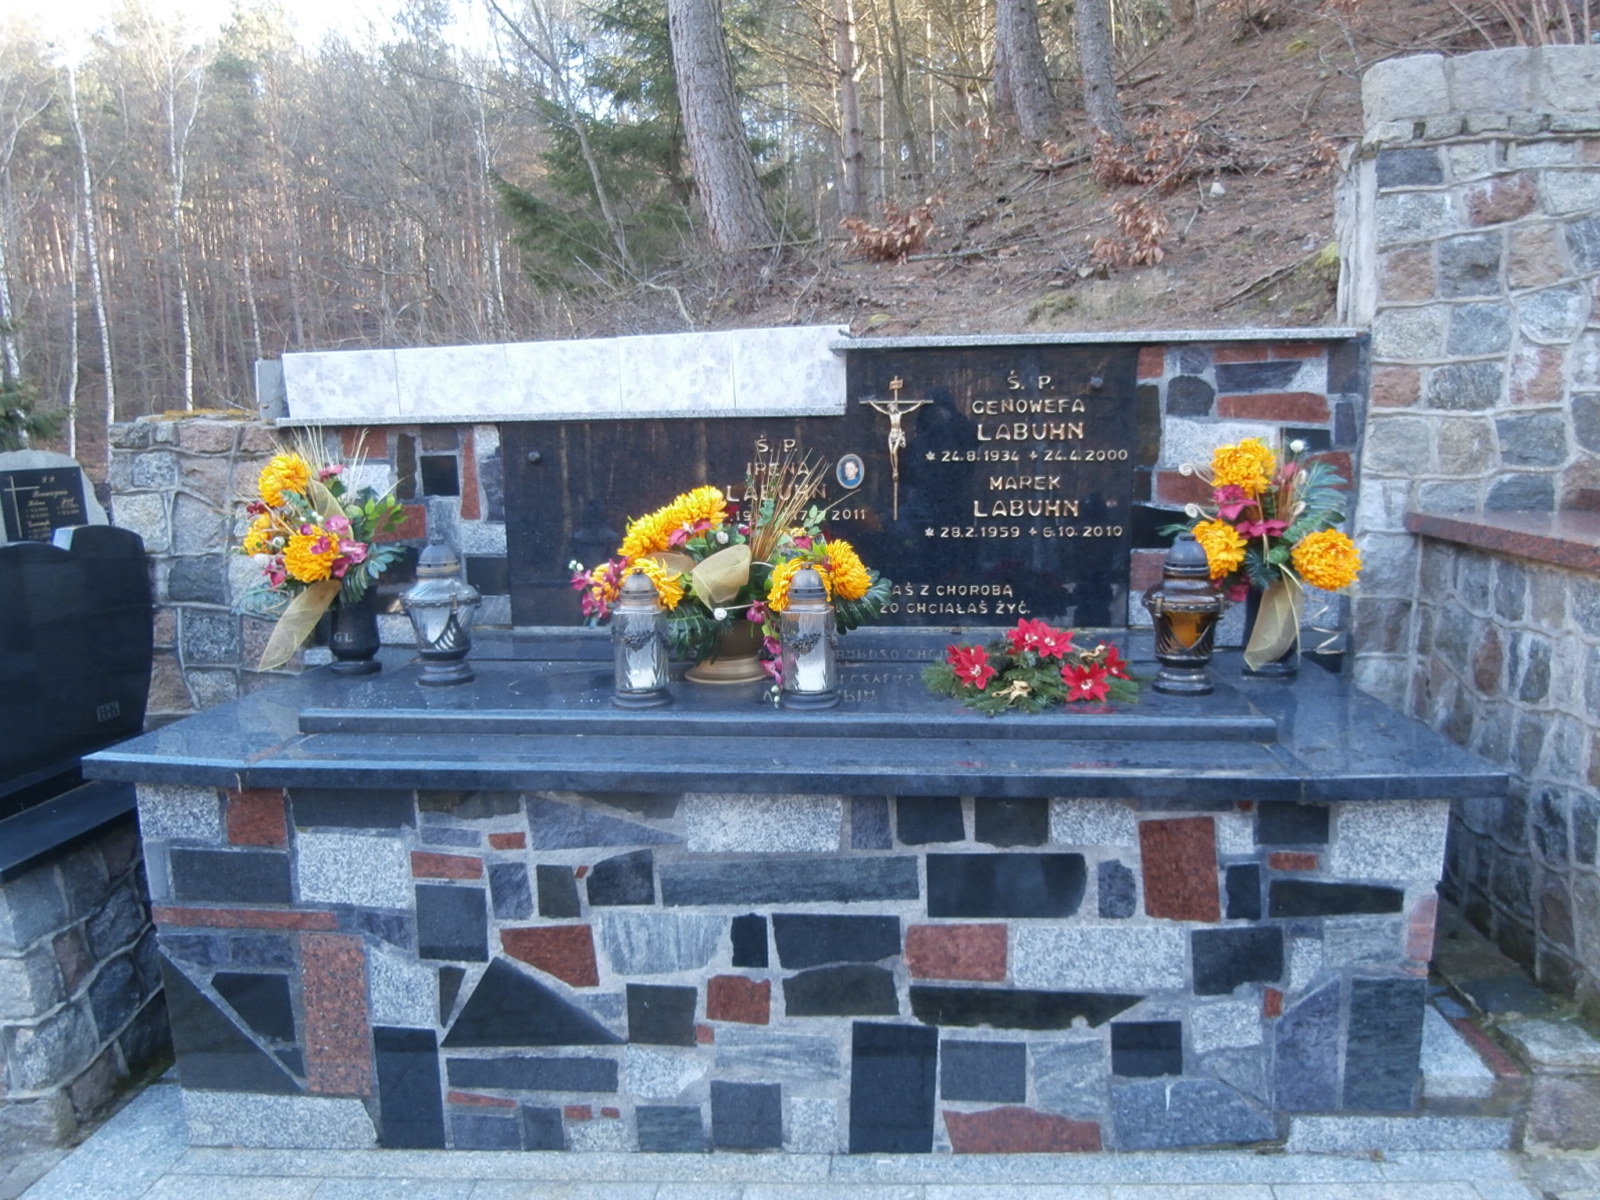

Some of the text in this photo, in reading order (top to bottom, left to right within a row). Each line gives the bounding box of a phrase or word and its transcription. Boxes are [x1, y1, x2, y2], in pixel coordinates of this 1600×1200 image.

[1038, 375, 1055, 390] P.
[972, 399, 1085, 415] GENOWEFA
[977, 422, 1084, 441] LABUHN
[941, 450, 1020, 462] 24.8.1934
[989, 476, 1061, 490] MAREK
[973, 500, 1079, 517] LABUHN
[940, 527, 1020, 538] 28.2.1959
[920, 584, 930, 596] Z
[936, 584, 1014, 598] CHOROBĄ
[906, 600, 989, 615] CHCIAŁAŚ
